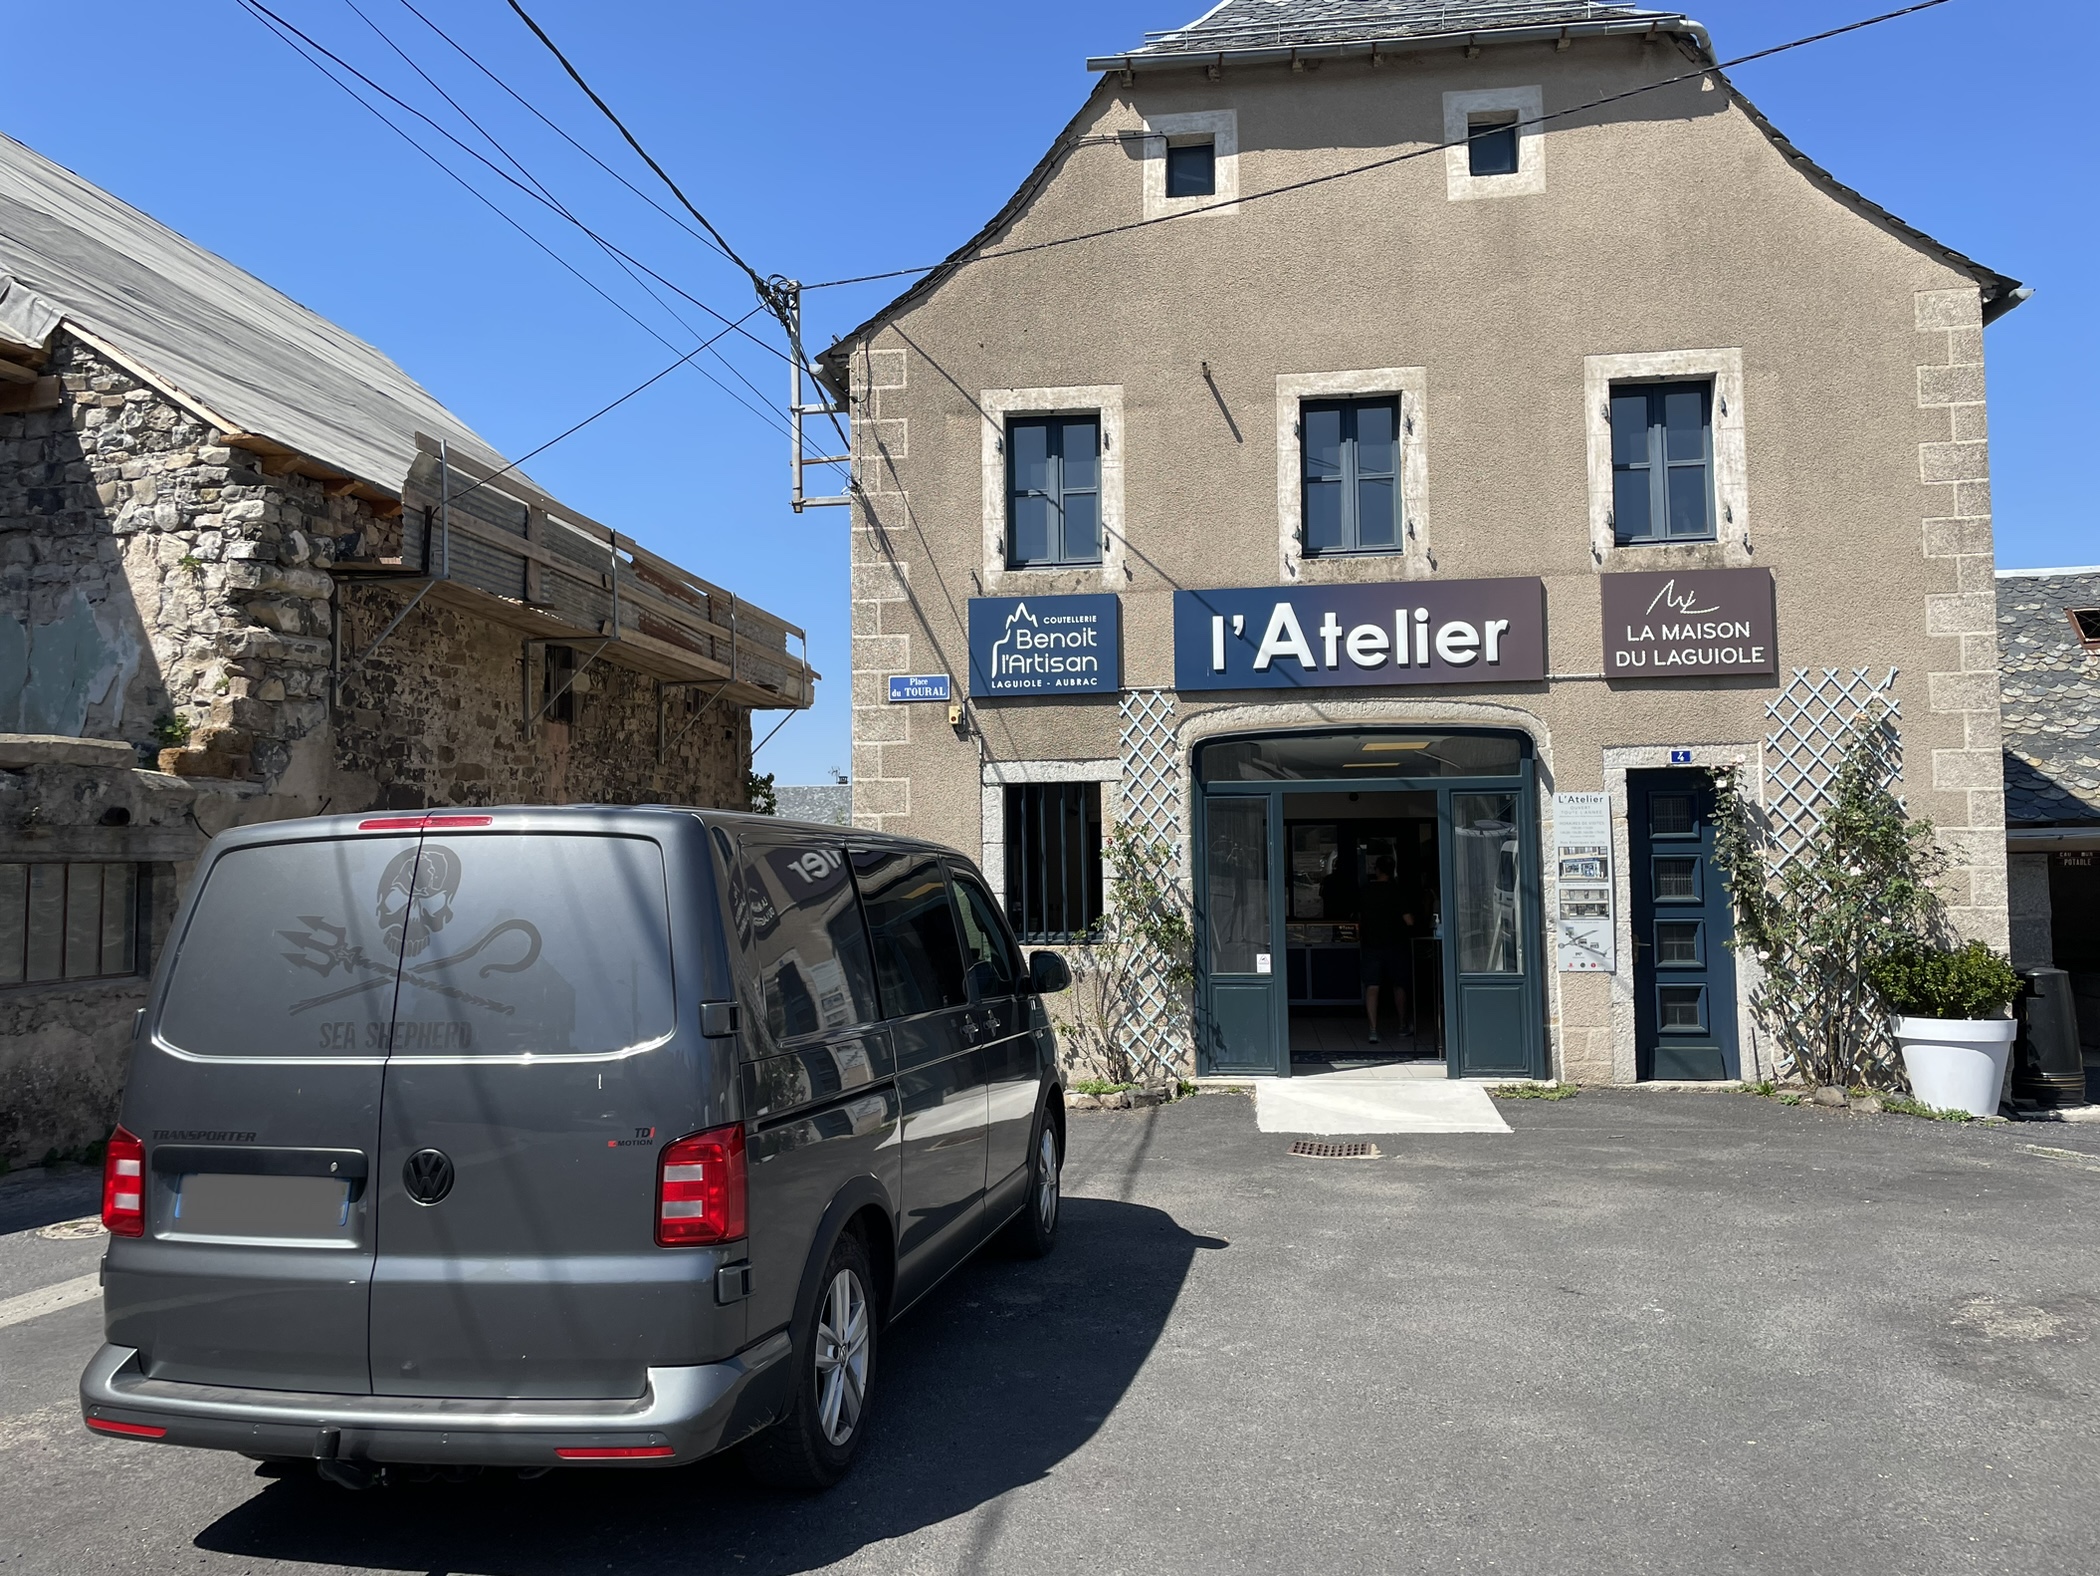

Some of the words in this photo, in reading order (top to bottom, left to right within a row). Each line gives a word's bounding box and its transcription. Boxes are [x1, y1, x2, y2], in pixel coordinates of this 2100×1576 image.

[1043, 615, 1097, 624] COUTELLERIE
[1212, 602, 1510, 670] l'Atelier
[1627, 625, 1655, 642] LA
[1662, 621, 1750, 640] MAISON
[1016, 627, 1097, 649] Benoit
[1616, 650, 1646, 667] DU
[1654, 647, 1765, 666] LAGUIOLE
[1002, 653, 1098, 674] l'Artisan
[910, 677, 929, 686] Place
[991, 680, 1042, 689] LAGUIOLE
[1055, 678, 1098, 687] AUBRAC
[891, 689, 902, 697] du
[904, 687, 946, 697] TOURAL
[1677, 751, 1684, 761] 4
[1558, 795, 1603, 803] L'Atelier
[319, 1021, 356, 1049] SEA
[365, 1021, 473, 1049] SHEPHERD
[152, 1130, 257, 1142] TRANSPORTER
[635, 1126, 656, 1139] TDI
